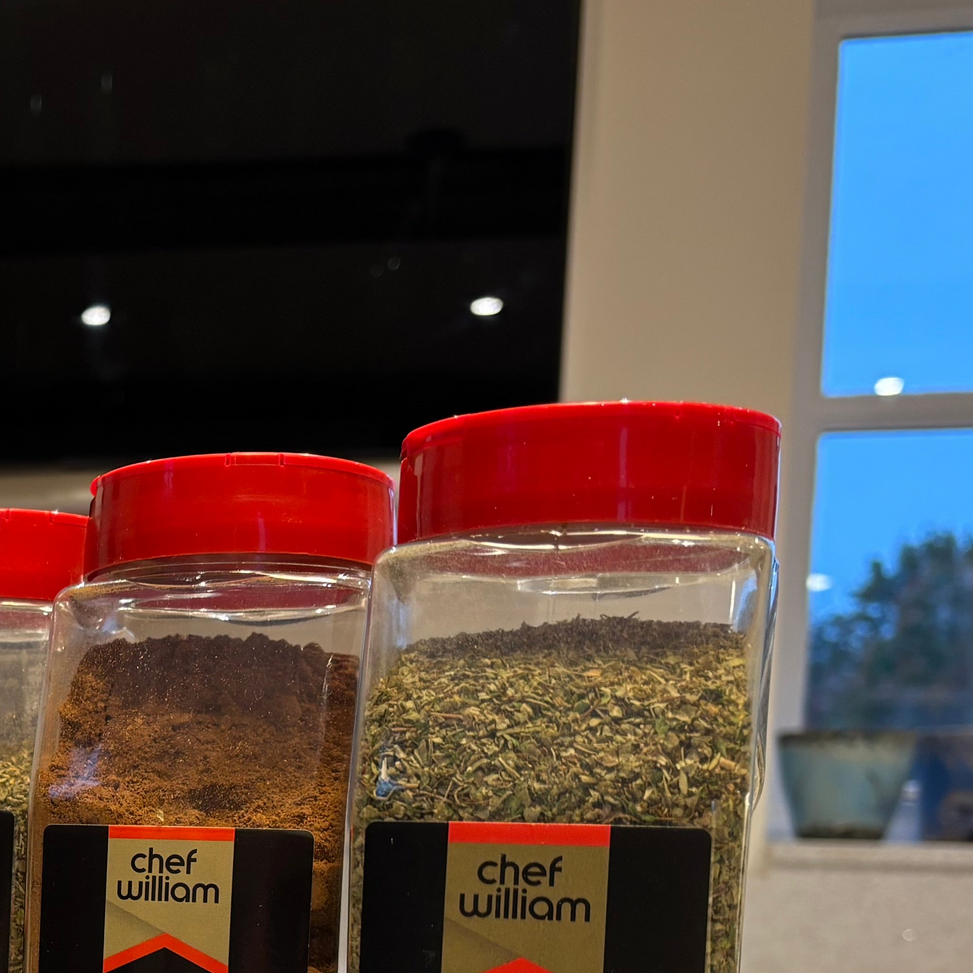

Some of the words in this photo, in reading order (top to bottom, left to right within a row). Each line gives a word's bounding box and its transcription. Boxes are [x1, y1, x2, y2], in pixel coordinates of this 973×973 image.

[130, 847, 197, 874] chef
[477, 853, 563, 887] chef
[116, 876, 219, 904] william
[459, 887, 591, 922] william
